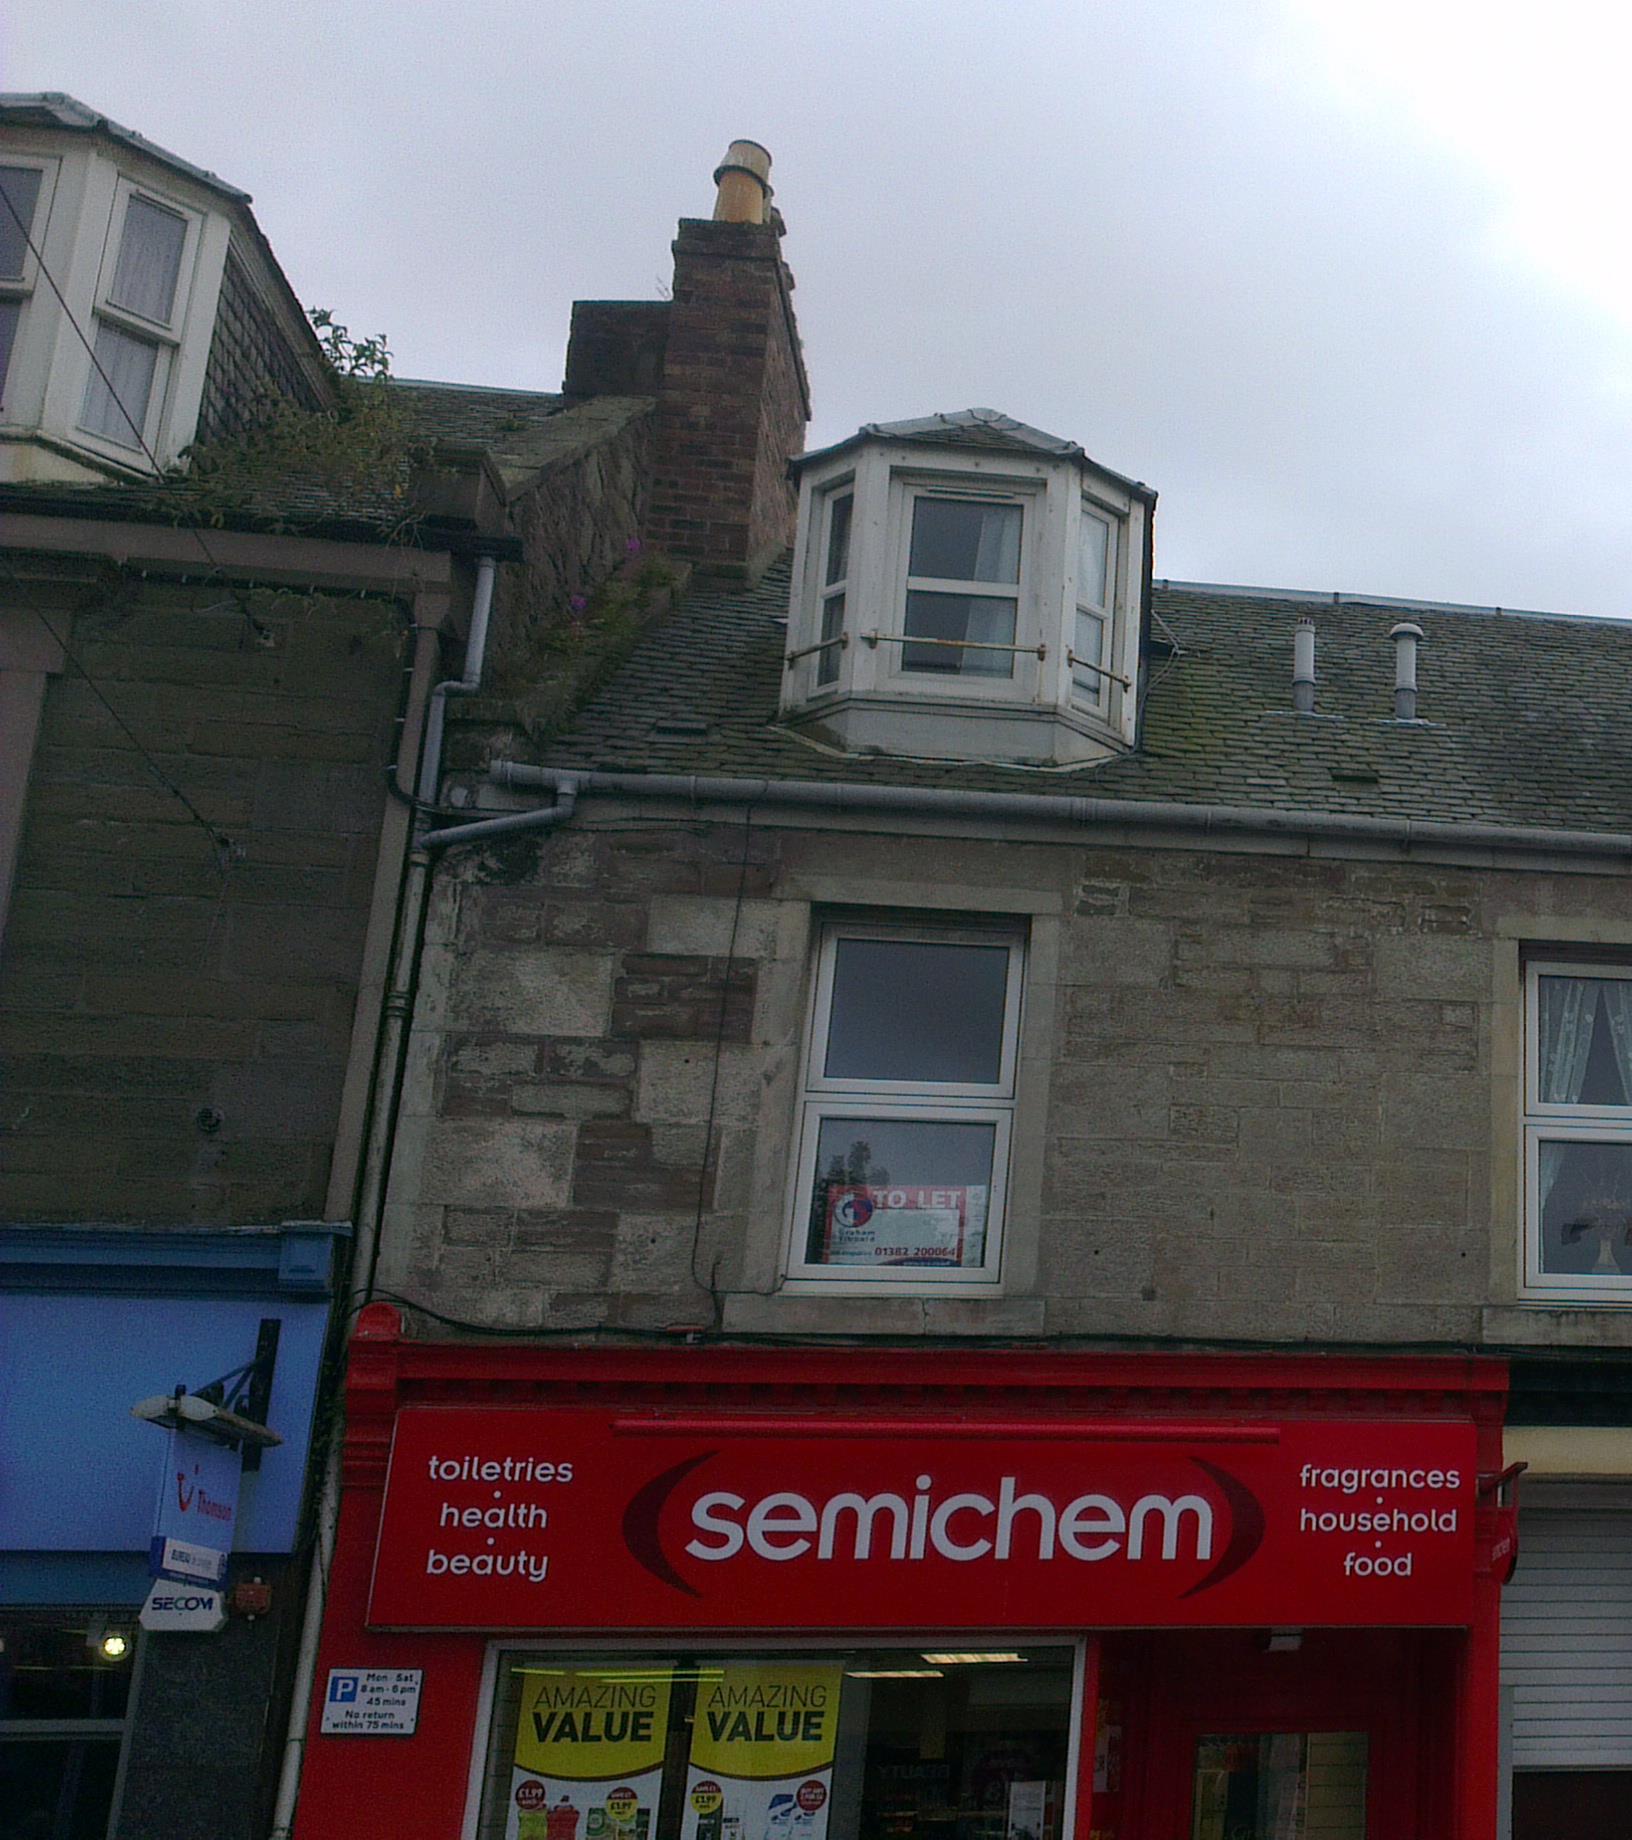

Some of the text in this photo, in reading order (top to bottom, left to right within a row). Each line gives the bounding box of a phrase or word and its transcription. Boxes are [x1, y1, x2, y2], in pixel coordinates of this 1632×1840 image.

[874, 1190, 961, 1208] TO LET
[428, 1455, 575, 1482] toiletries
[1299, 1463, 1462, 1495] fragrances
[439, 1502, 548, 1528] health
[684, 1473, 1214, 1563] semichem
[1299, 1507, 1458, 1533] household
[425, 1550, 550, 1582] beauty
[1343, 1551, 1415, 1577] food
[151, 1597, 214, 1611] SECOM
[366, 1673, 414, 1682] Mon Sat
[366, 1697, 406, 1706] 45 mins
[400, 1686, 416, 1695] pm
[532, 1685, 657, 1709] AMAZING
[707, 1684, 828, 1709] AMAZING
[332, 1720, 363, 1729] within
[380, 1720, 404, 1729] mins
[345, 1710, 395, 1719] No return
[532, 1711, 655, 1743] VALUE
[706, 1710, 824, 1742] VALUE
[518, 1788, 544, 1799] £1.99
